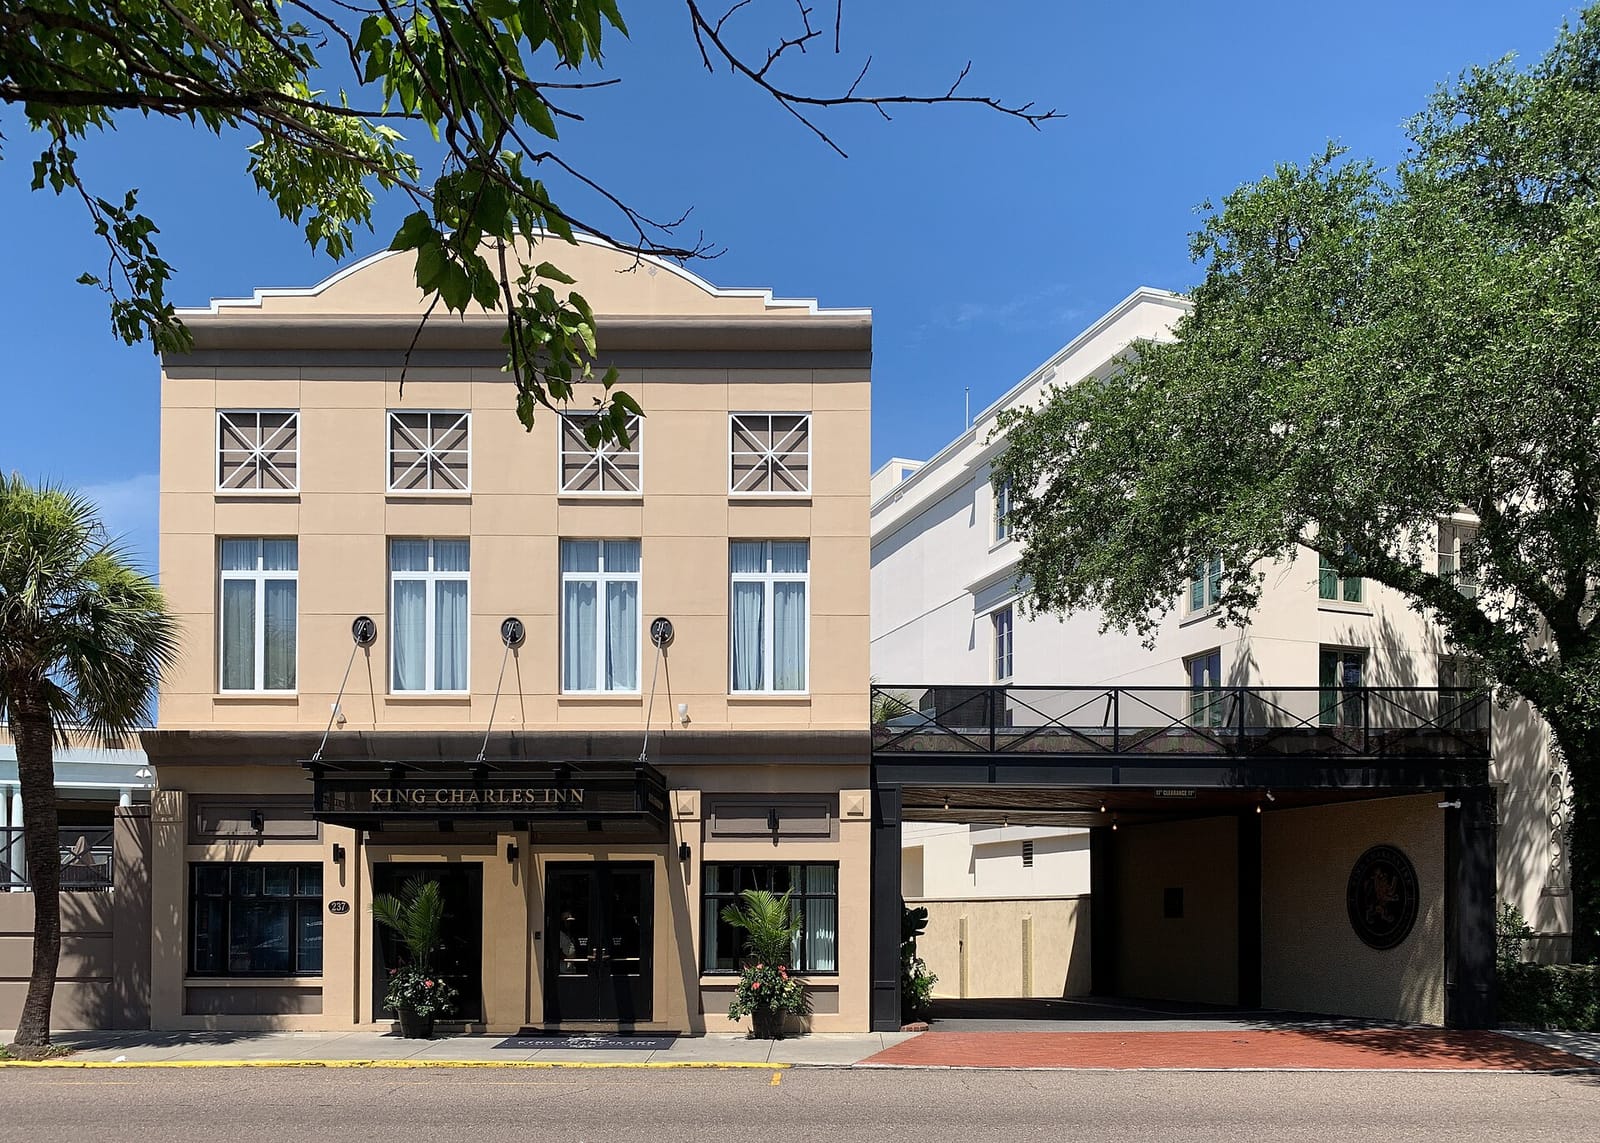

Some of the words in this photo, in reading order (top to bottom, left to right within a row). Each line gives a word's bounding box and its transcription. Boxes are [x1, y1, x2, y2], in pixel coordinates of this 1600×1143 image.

[369, 788, 426, 803] KING
[435, 788, 536, 803] CHARLES
[544, 788, 585, 803] INN
[331, 902, 346, 911] 237
